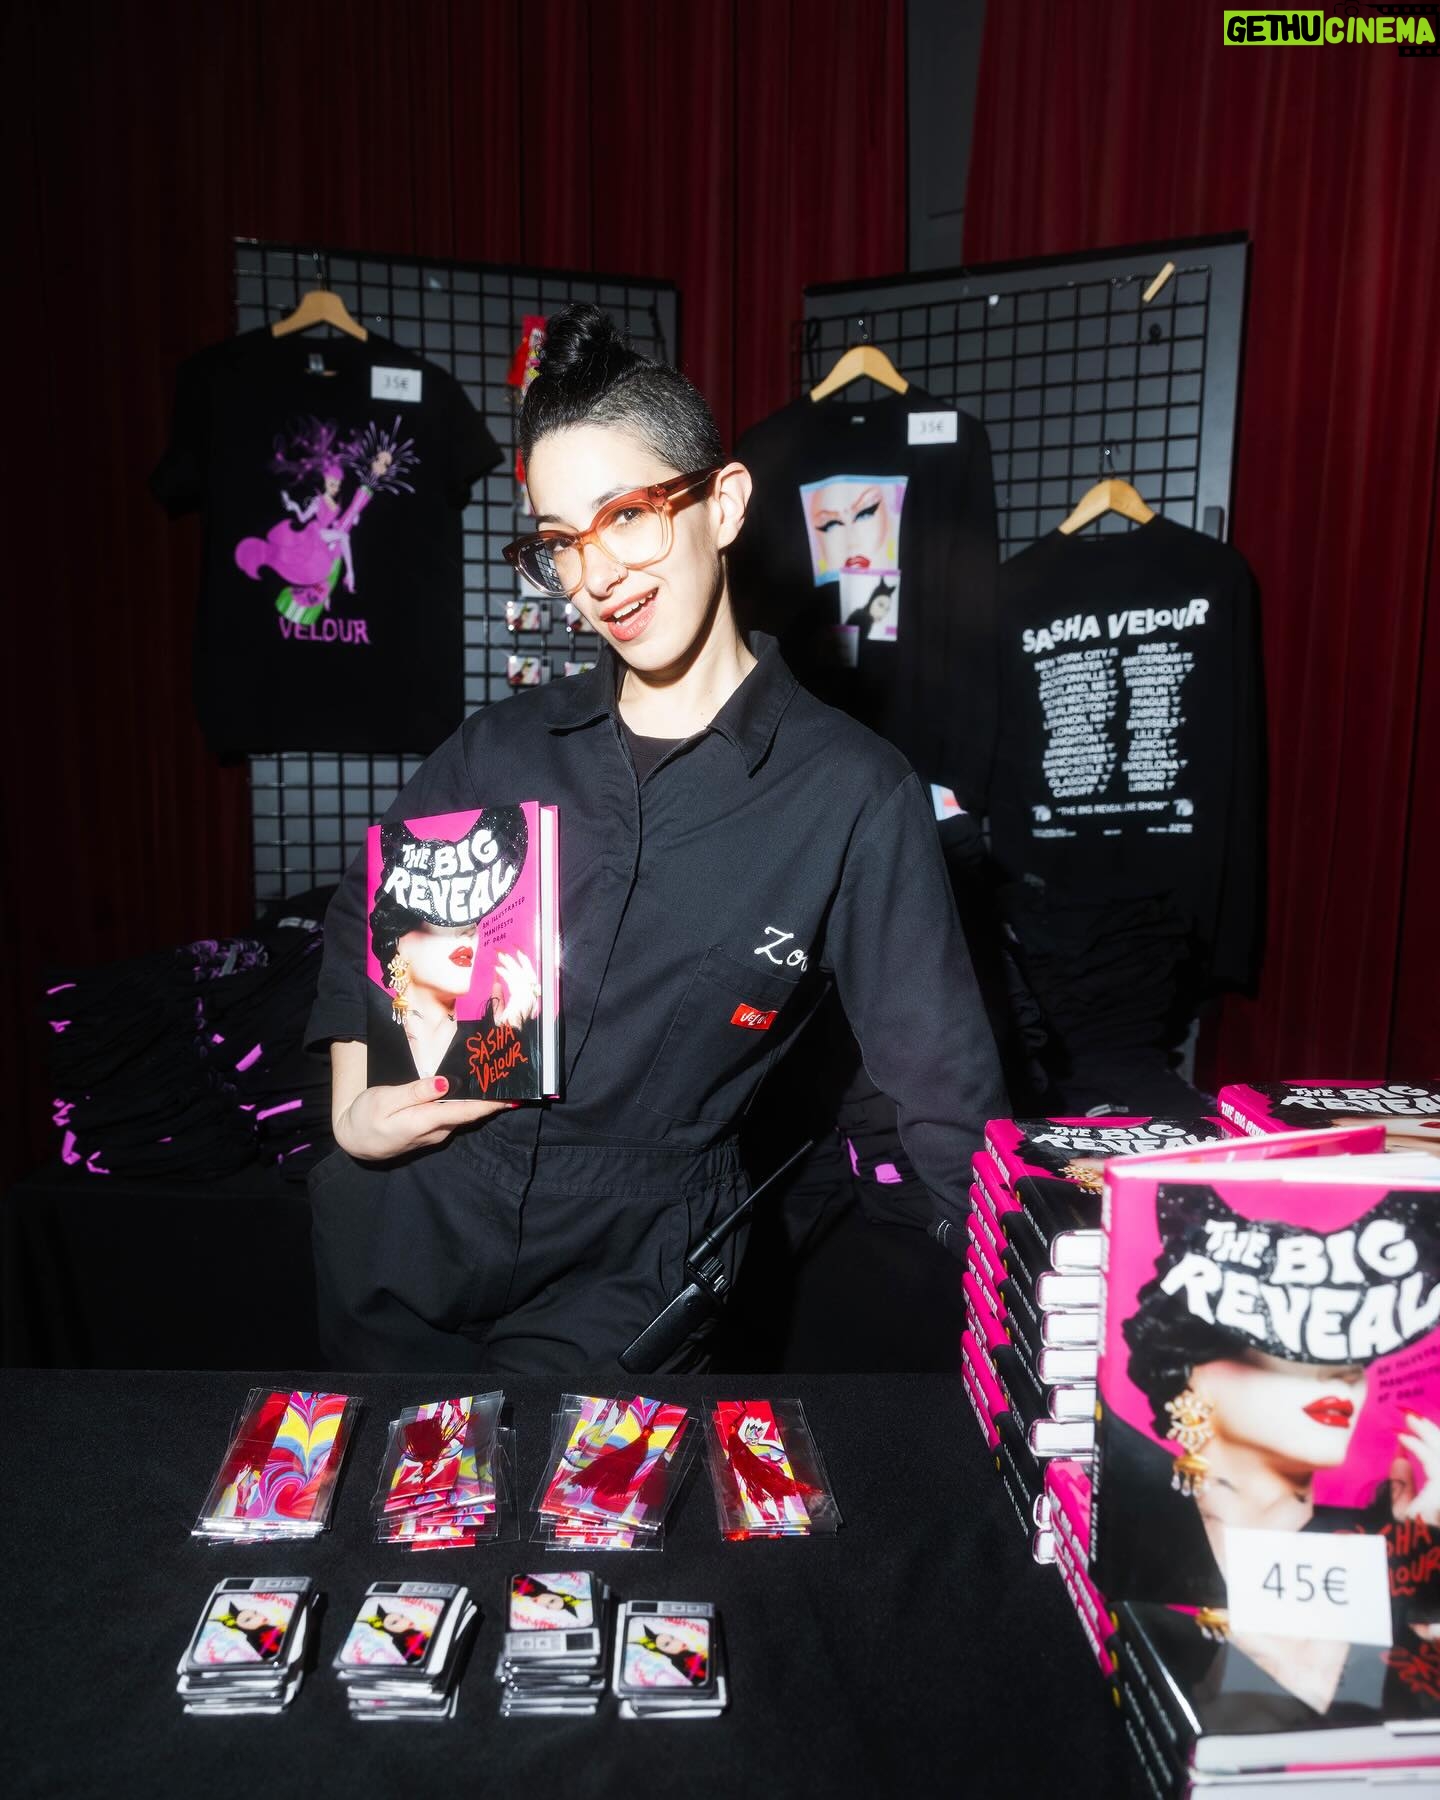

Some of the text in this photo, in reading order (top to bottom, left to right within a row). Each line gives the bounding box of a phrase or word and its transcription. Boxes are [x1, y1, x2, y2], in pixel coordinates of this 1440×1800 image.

[279, 616, 369, 644] VELOUR
[1022, 598, 1209, 653] SASHA VELOUR
[403, 829, 499, 878] THE BIG
[384, 859, 517, 922] REVEAL
[466, 1019, 515, 1074] SASHA
[476, 1041, 528, 1093] VELOUR
[1281, 1094, 1440, 1114] REVEA
[1289, 1085, 1429, 1101] THE BIG
[1050, 1124, 1186, 1140] THE BIG
[1204, 1218, 1419, 1285] THE BIG
[1159, 1250, 1440, 1360] REVEAL
[1262, 1562, 1349, 1605] 45€
